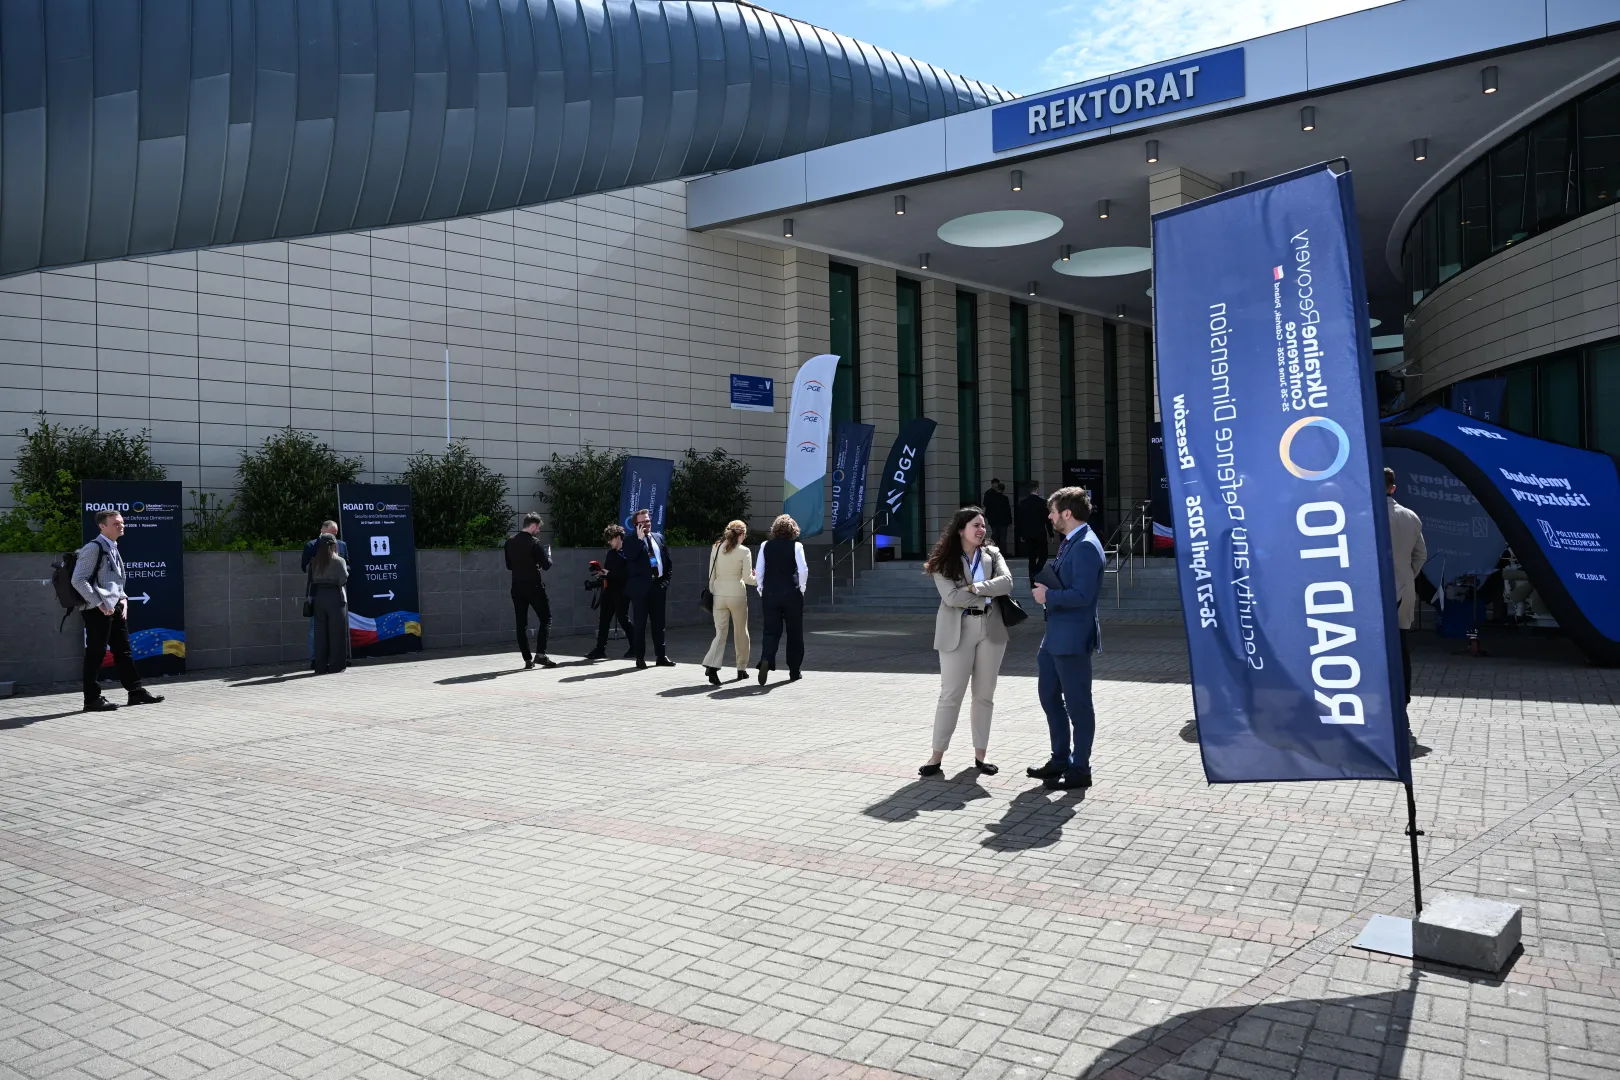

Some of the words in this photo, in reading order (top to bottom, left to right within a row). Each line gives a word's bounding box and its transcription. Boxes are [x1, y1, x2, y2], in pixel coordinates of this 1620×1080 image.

[1028, 65, 1200, 134] REKTORAT
[803, 415, 819, 423] PGE
[893, 444, 917, 484] PGZ
[1499, 467, 1571, 490] Budujemy
[649, 483, 657, 514] Dimension
[1510, 487, 1591, 507] przyszłość!
[85, 502, 114, 511] ROAD
[116, 502, 130, 511] TO
[342, 503, 363, 511] ROAD
[364, 503, 375, 511] TO
[1556, 530, 1601, 539] POLITECHNIKA
[1560, 538, 1601, 547] RZESZOWSKA
[123, 561, 167, 569] FERENCJA
[364, 563, 398, 571] TOALETY
[125, 570, 166, 579] FERENCE
[366, 572, 398, 581] TOILETS
[1575, 572, 1608, 581] PRZ.EDU.PL
